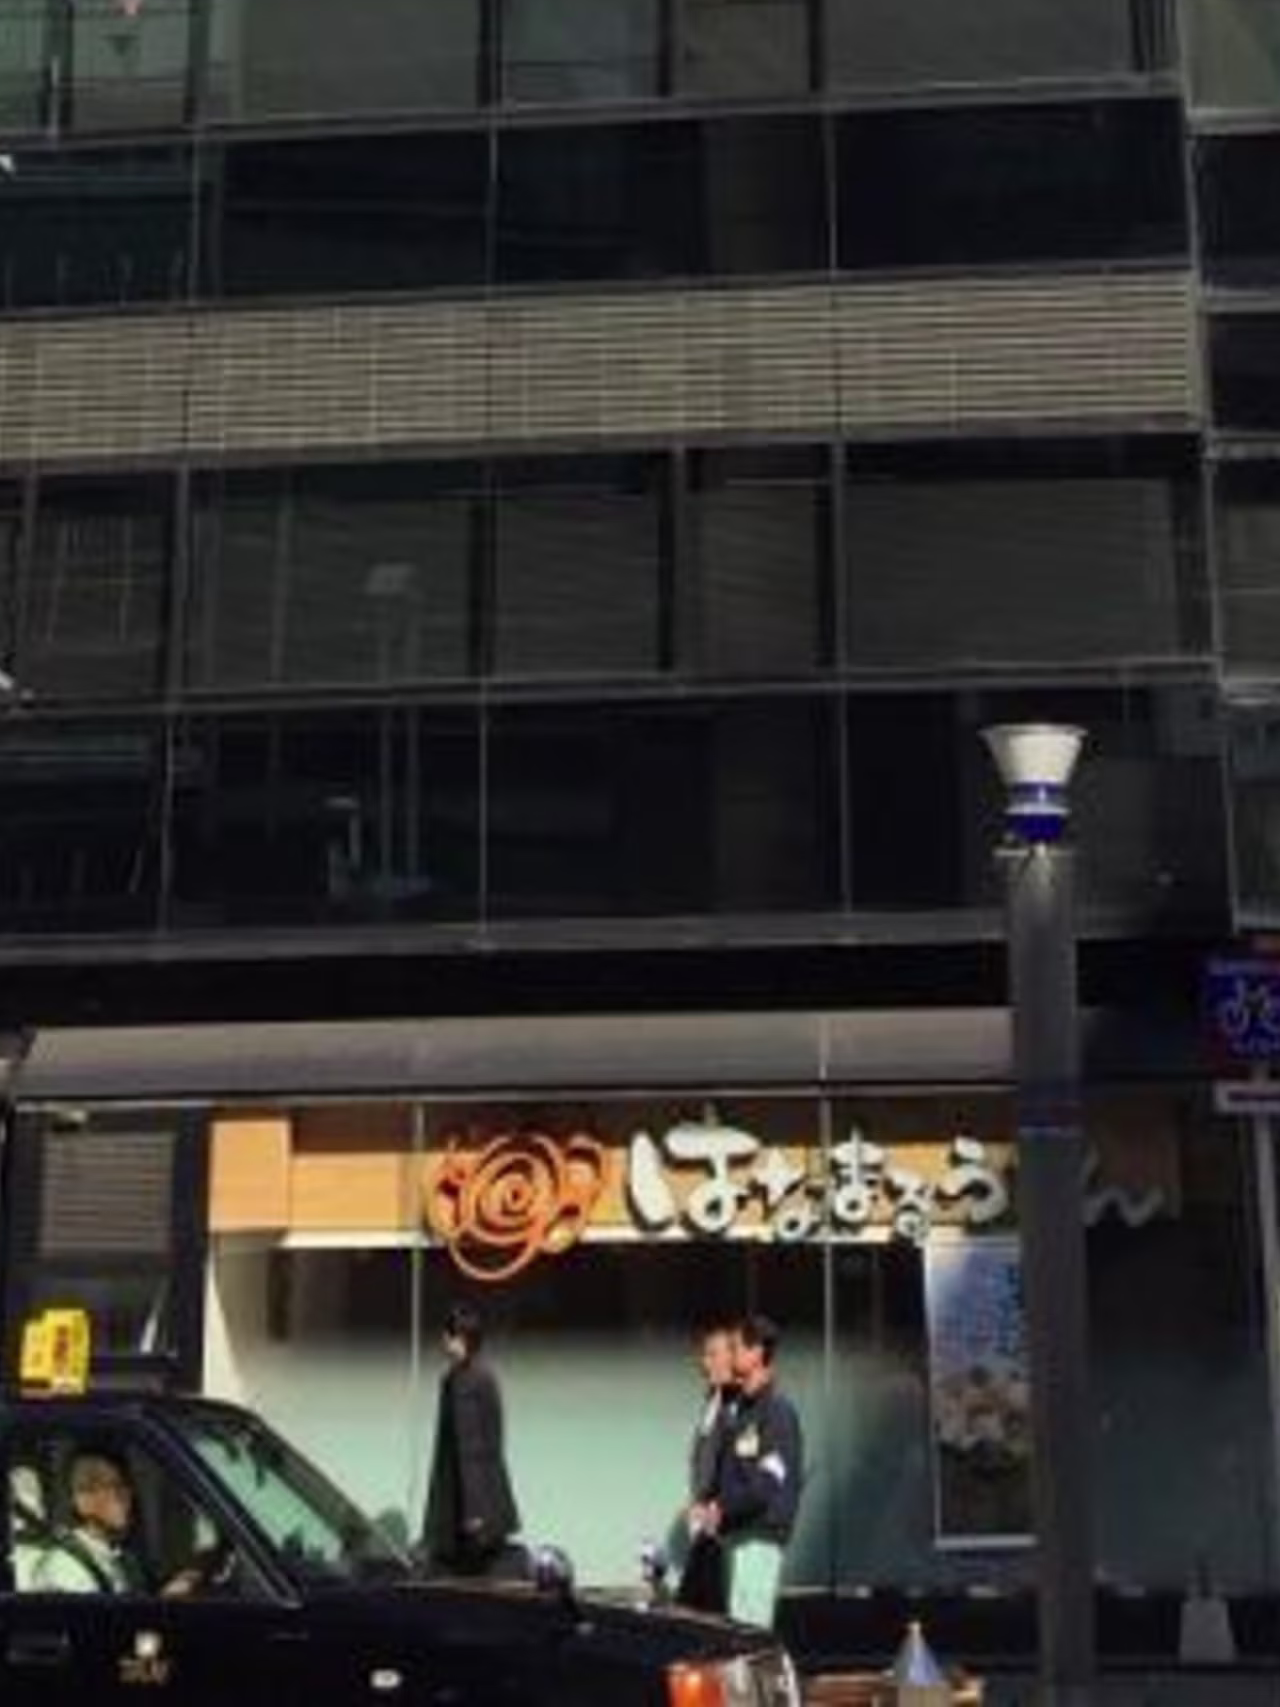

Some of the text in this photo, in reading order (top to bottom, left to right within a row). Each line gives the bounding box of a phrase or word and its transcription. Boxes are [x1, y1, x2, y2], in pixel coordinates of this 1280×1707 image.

[628, 1101, 1166, 1243] はなまるうん
